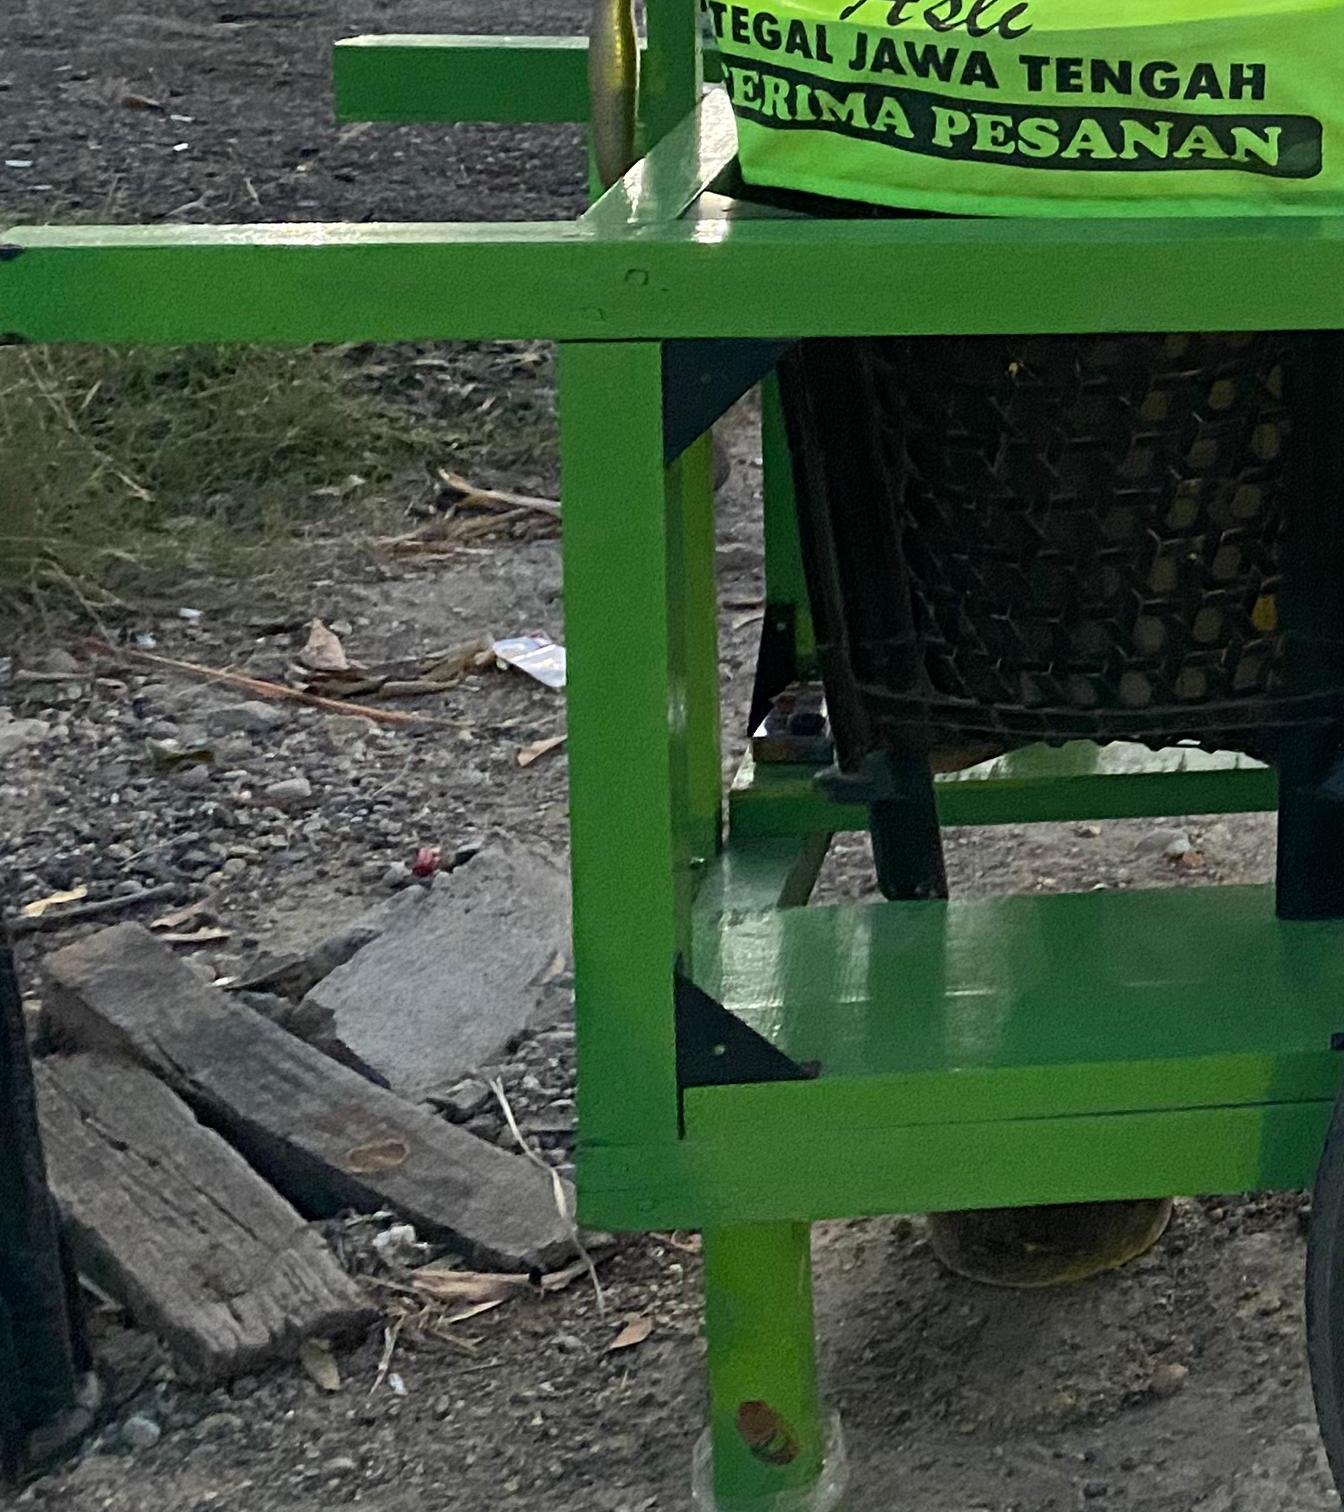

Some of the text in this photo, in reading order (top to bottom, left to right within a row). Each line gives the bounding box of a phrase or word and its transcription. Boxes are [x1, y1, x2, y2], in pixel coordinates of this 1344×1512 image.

[707, 0, 1267, 101] TEGAL JAWA TENGAH
[721, 61, 1283, 167] ERIMA PESANAN
